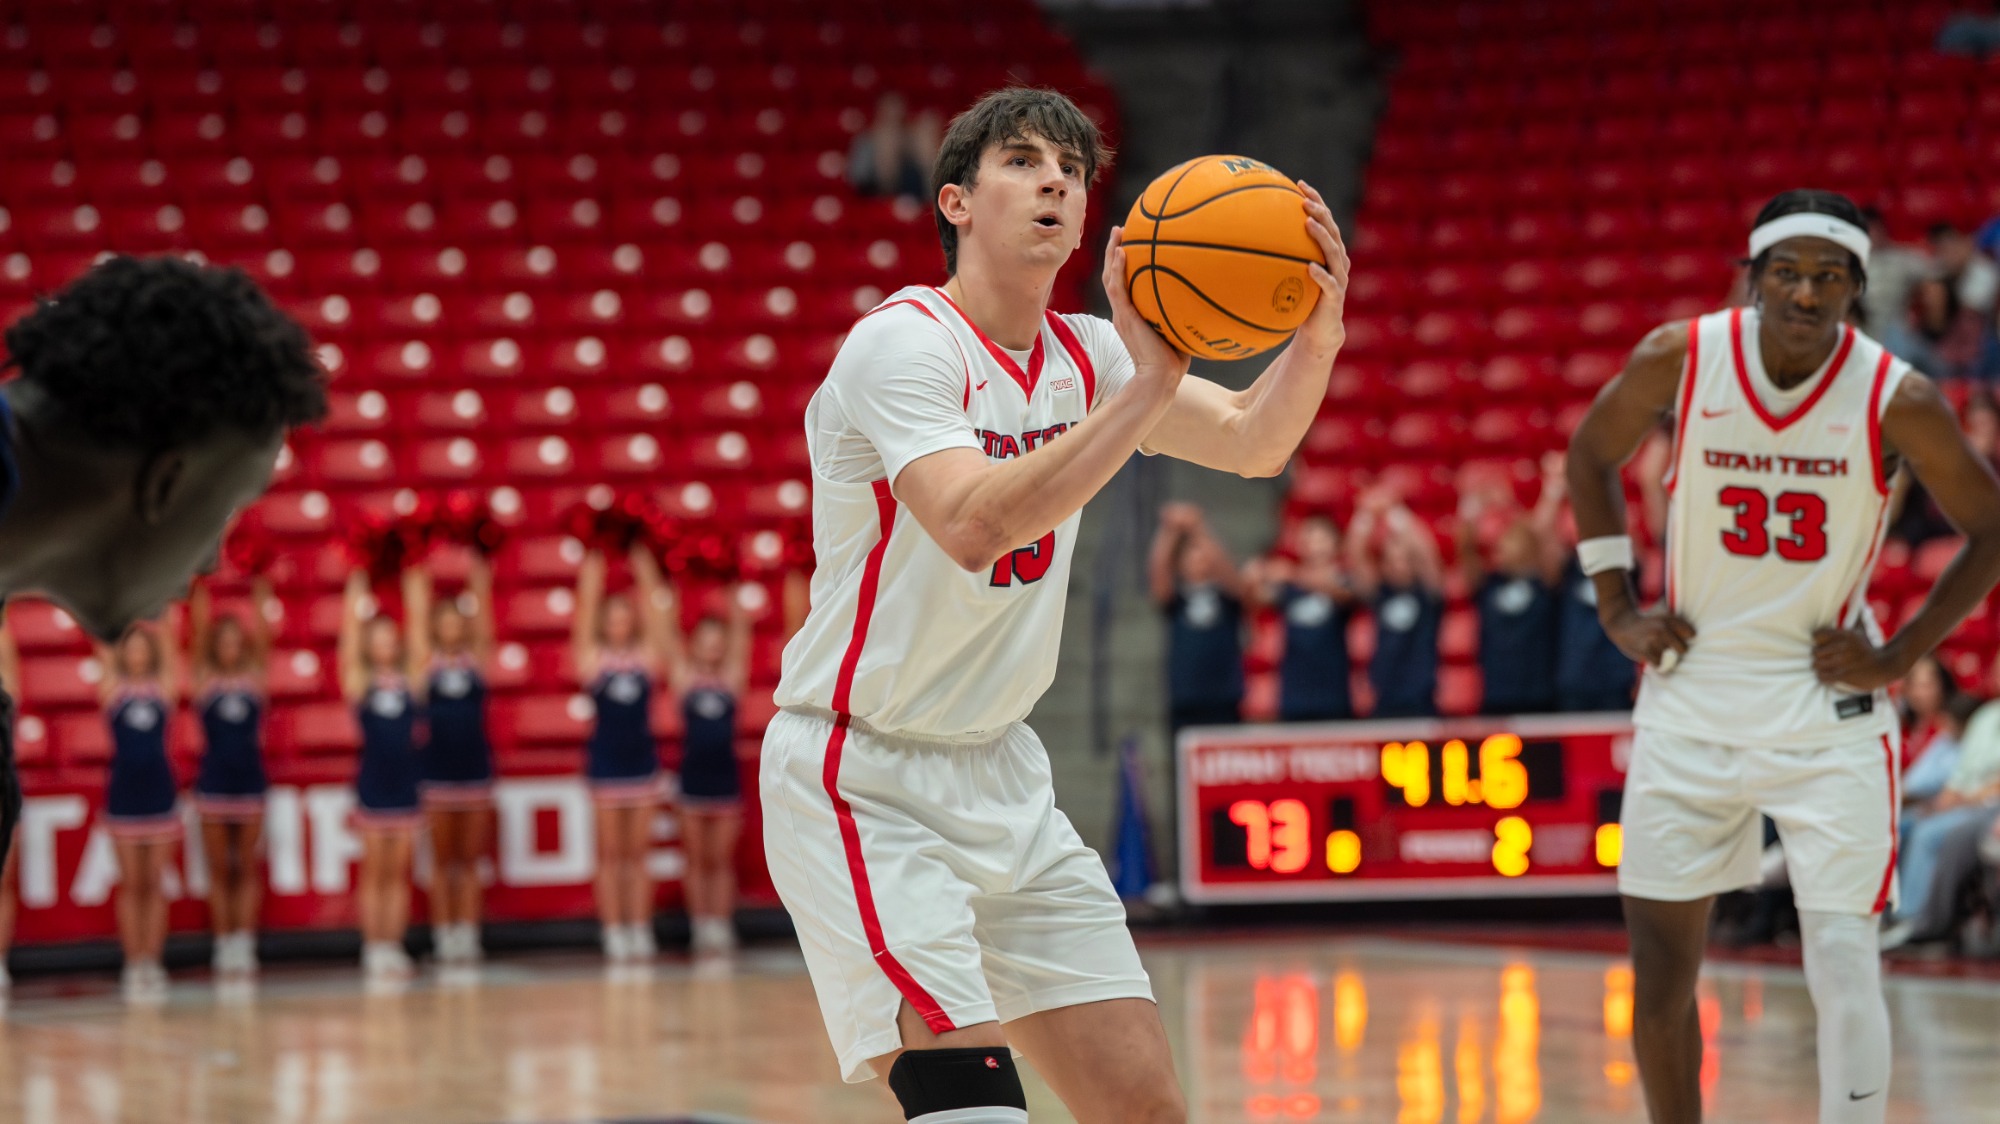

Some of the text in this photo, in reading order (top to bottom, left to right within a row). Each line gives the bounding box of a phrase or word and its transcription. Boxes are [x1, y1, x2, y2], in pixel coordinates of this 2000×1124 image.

[1050, 378, 1073, 391] WAC
[1704, 449, 1848, 476] UTAH TECH
[1718, 485, 1828, 562] 33
[1229, 799, 1311, 873] 73
